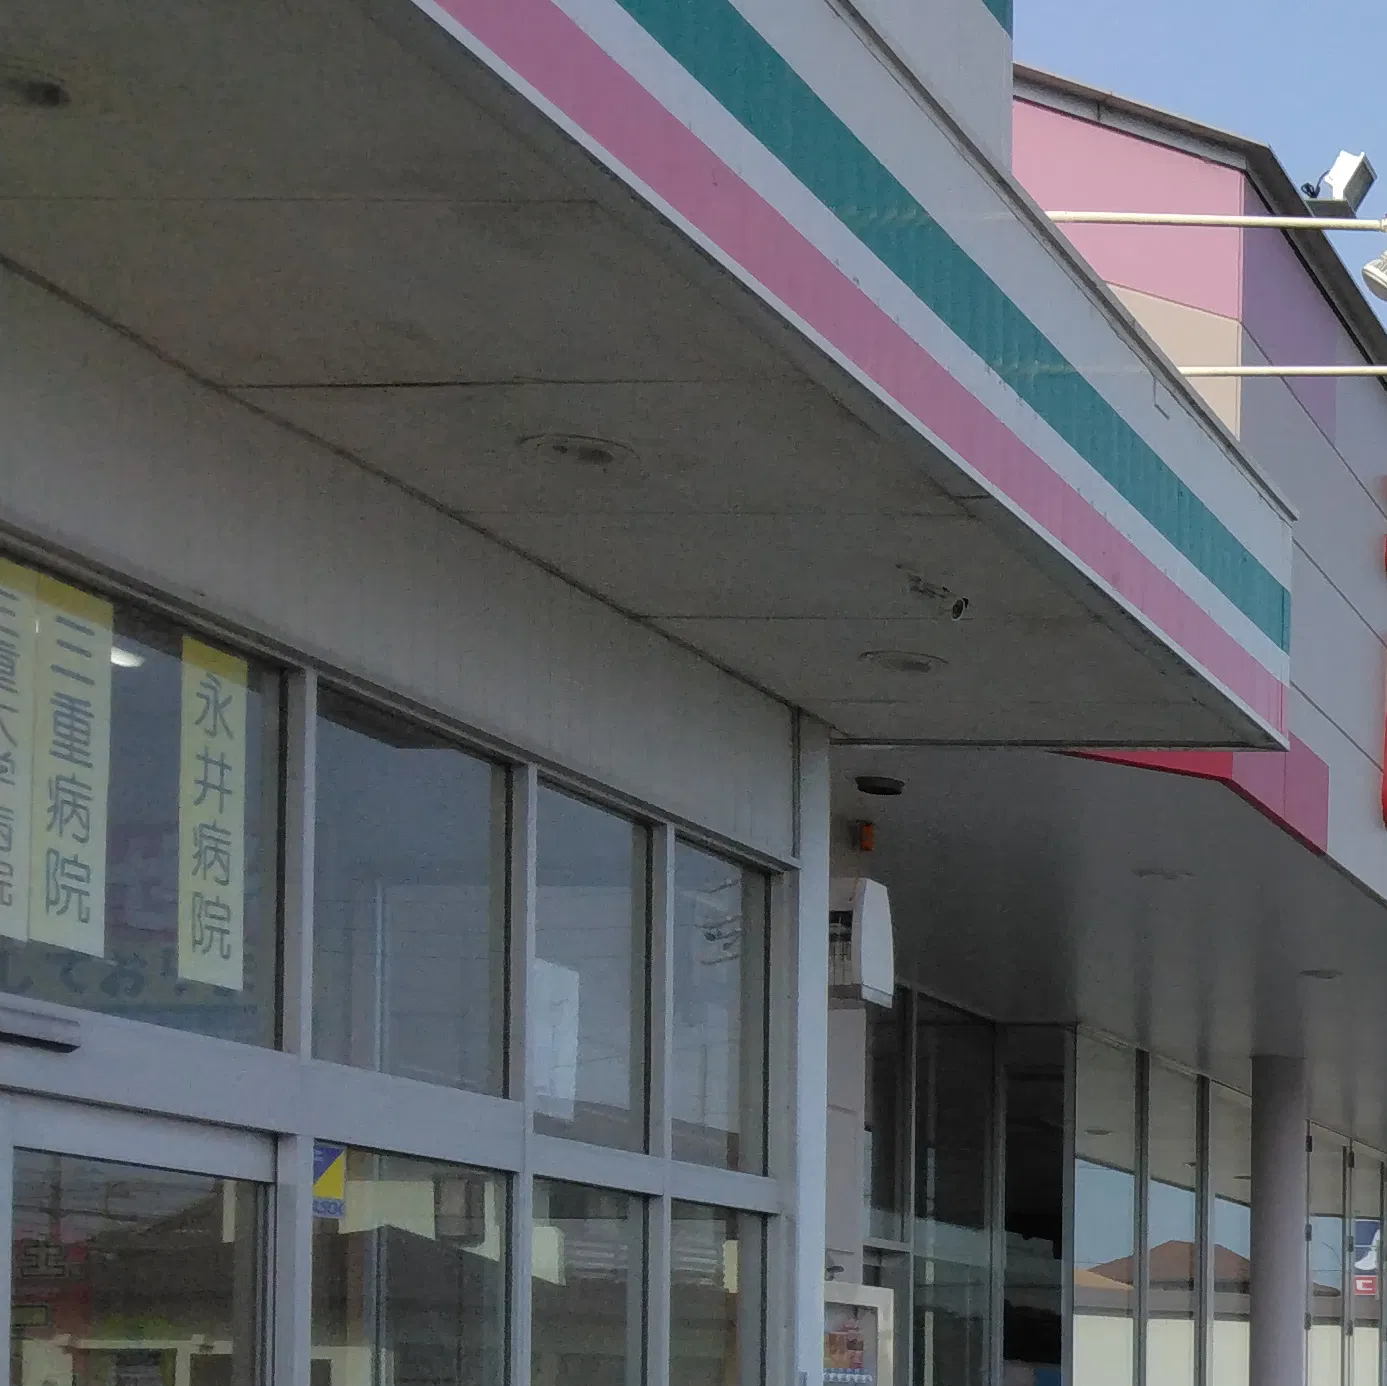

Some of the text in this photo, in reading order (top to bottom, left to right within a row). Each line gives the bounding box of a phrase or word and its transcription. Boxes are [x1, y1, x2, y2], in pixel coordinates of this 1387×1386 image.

[47, 614, 96, 924] 三重病院
[192, 671, 233, 961] 永井病院
